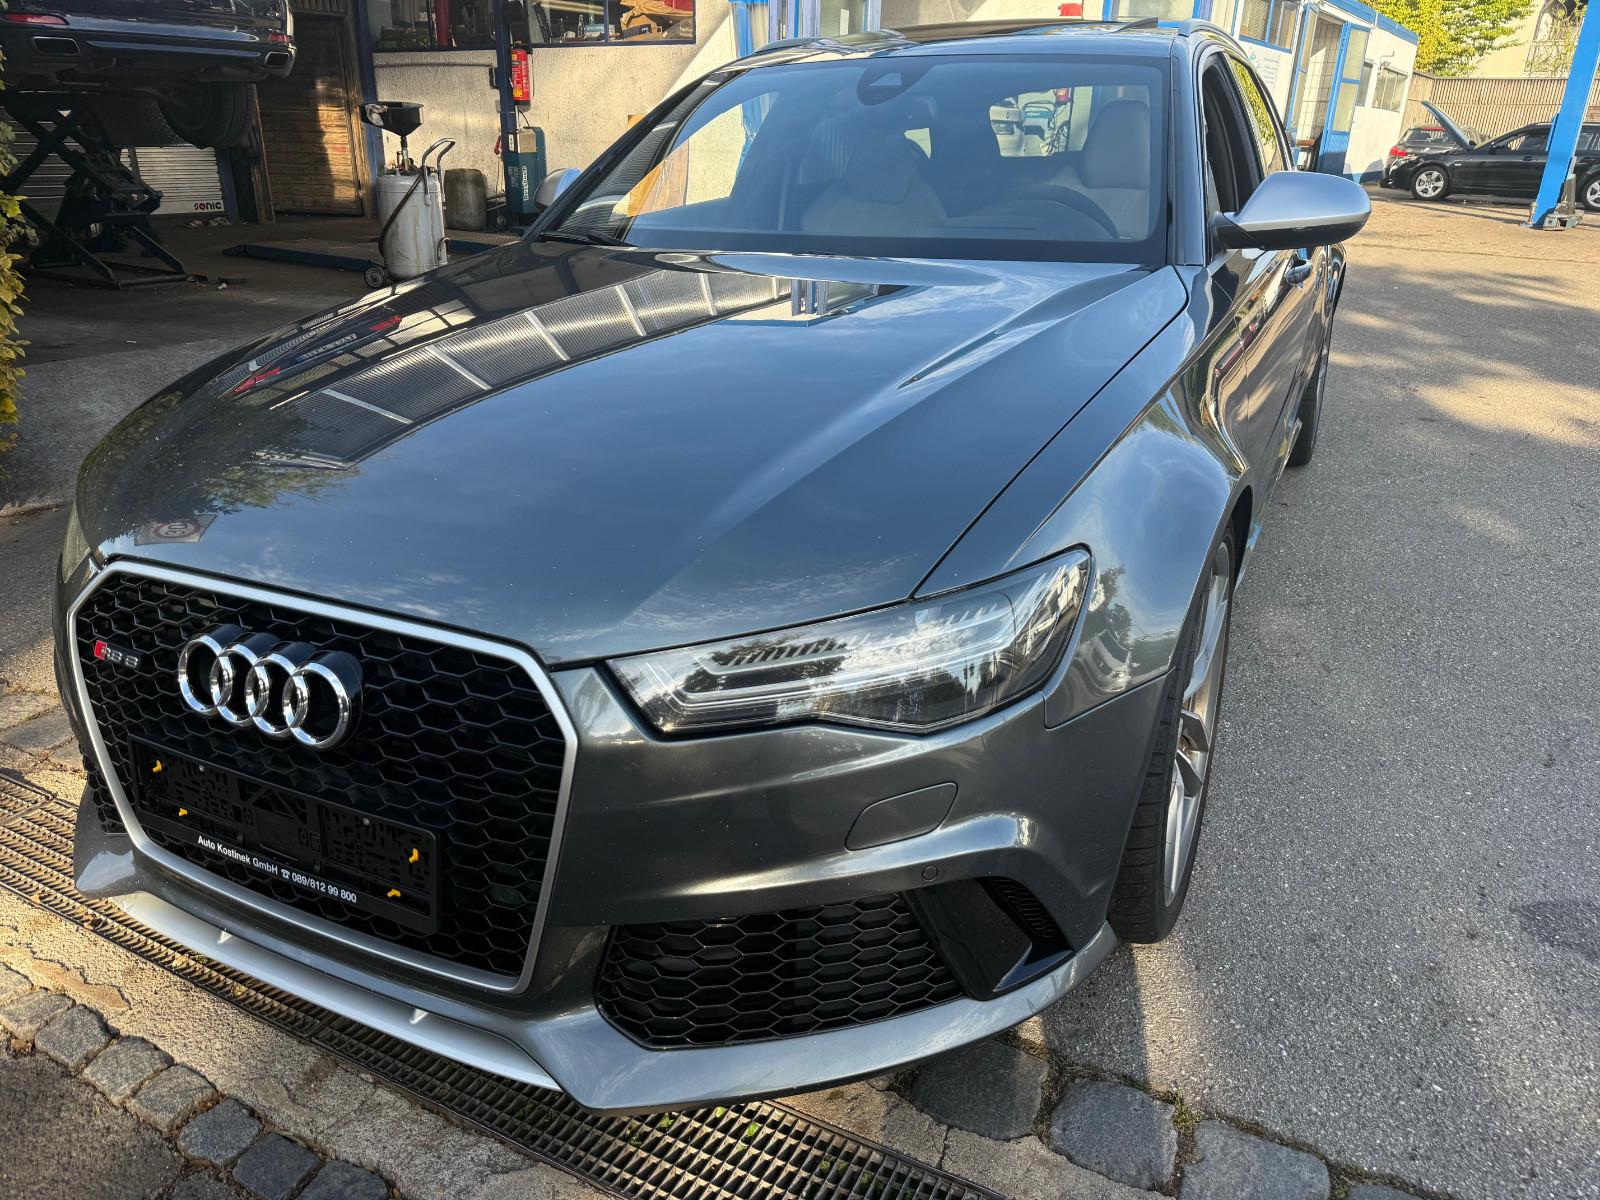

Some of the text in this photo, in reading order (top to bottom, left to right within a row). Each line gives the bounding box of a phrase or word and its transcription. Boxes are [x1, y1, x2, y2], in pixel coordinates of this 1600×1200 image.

[198, 835, 357, 903] Auto Kostinek GmbH 089/812 99 800
